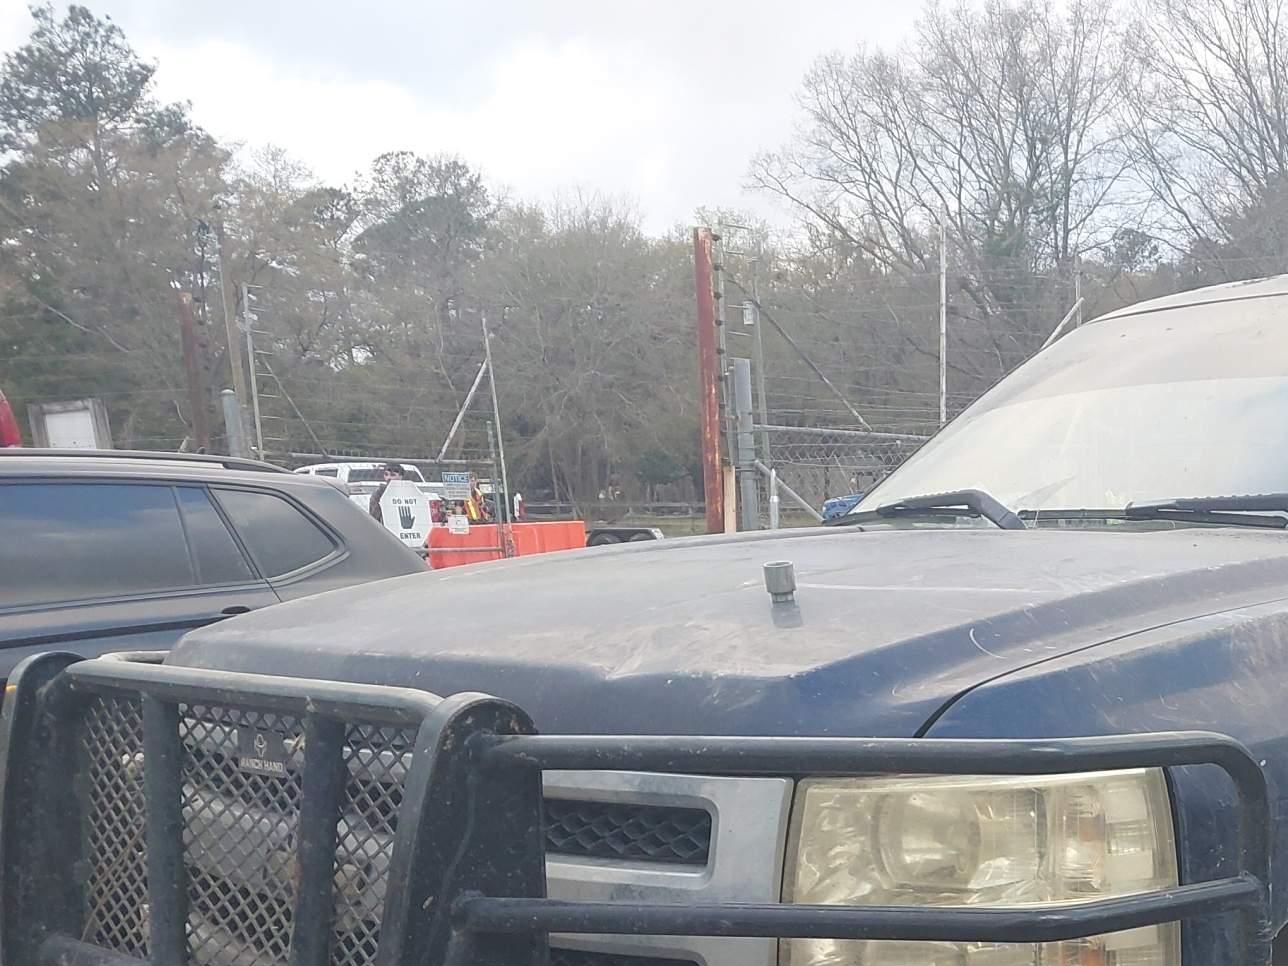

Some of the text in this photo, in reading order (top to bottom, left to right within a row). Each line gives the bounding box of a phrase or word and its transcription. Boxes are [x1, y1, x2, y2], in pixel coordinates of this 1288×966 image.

[444, 474, 468, 482] NOTICE
[400, 532, 421, 540] ENTER
[263, 760, 283, 772] HAND
